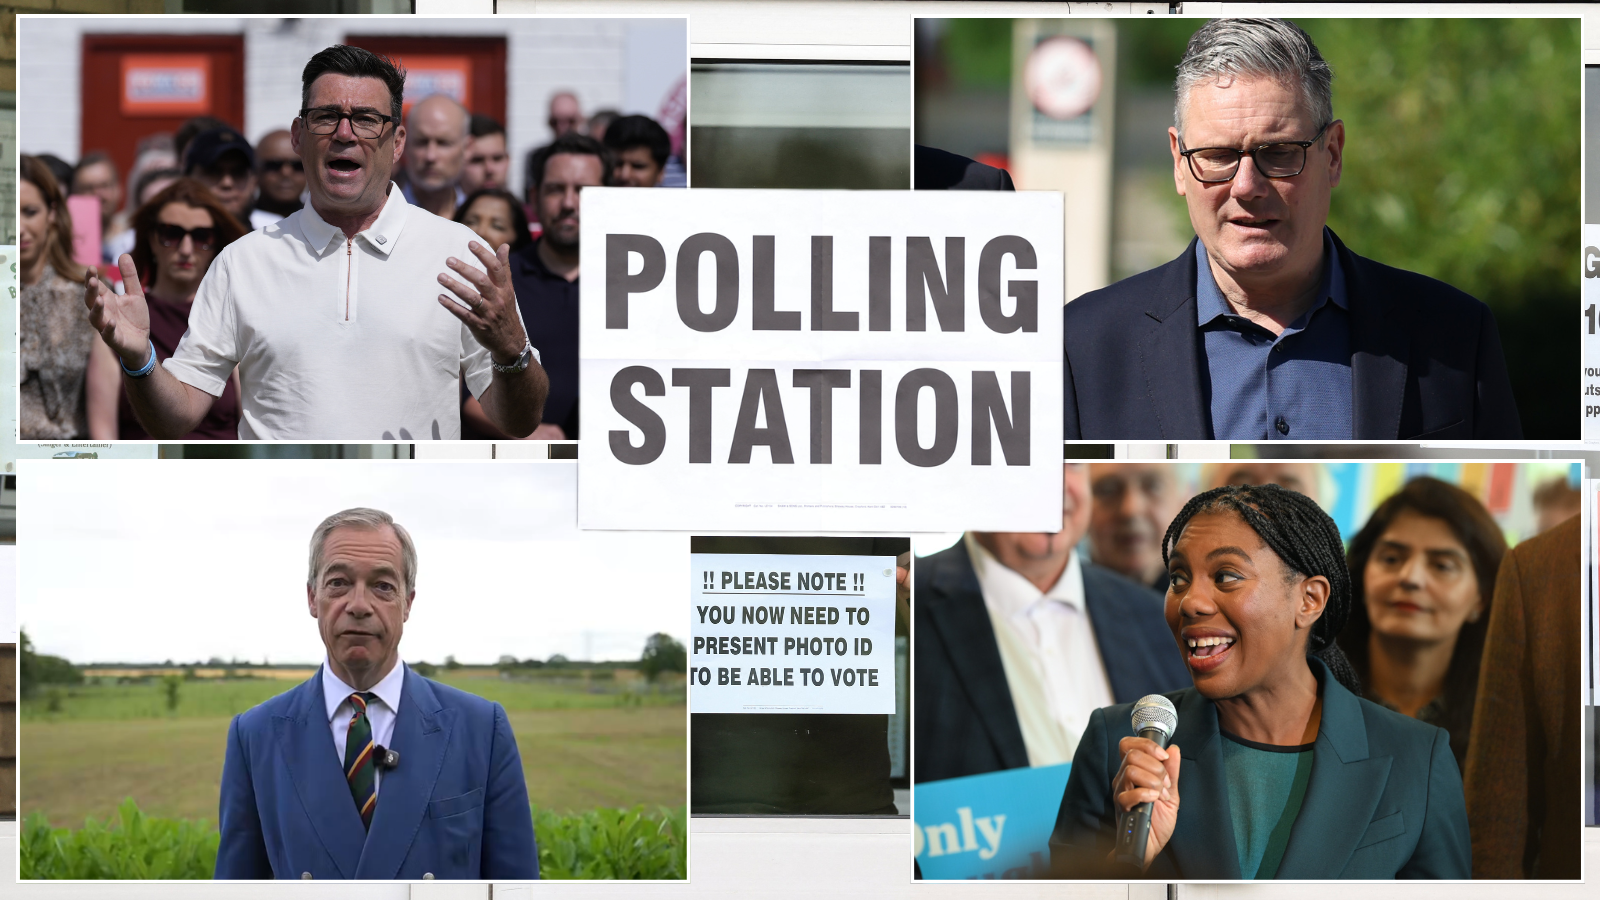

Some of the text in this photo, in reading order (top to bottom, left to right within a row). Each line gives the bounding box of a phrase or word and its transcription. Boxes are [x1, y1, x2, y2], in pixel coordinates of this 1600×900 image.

[606, 233, 1038, 334] POLLING
[609, 366, 1030, 467] STATION
[704, 571, 864, 591] !! PLEASE NOTE !!
[697, 606, 869, 625] YOU NOW NEED TO
[694, 637, 872, 656] PRESENT PHOTO ID
[691, 667, 878, 686] TO BE ABLE TO VOTE
